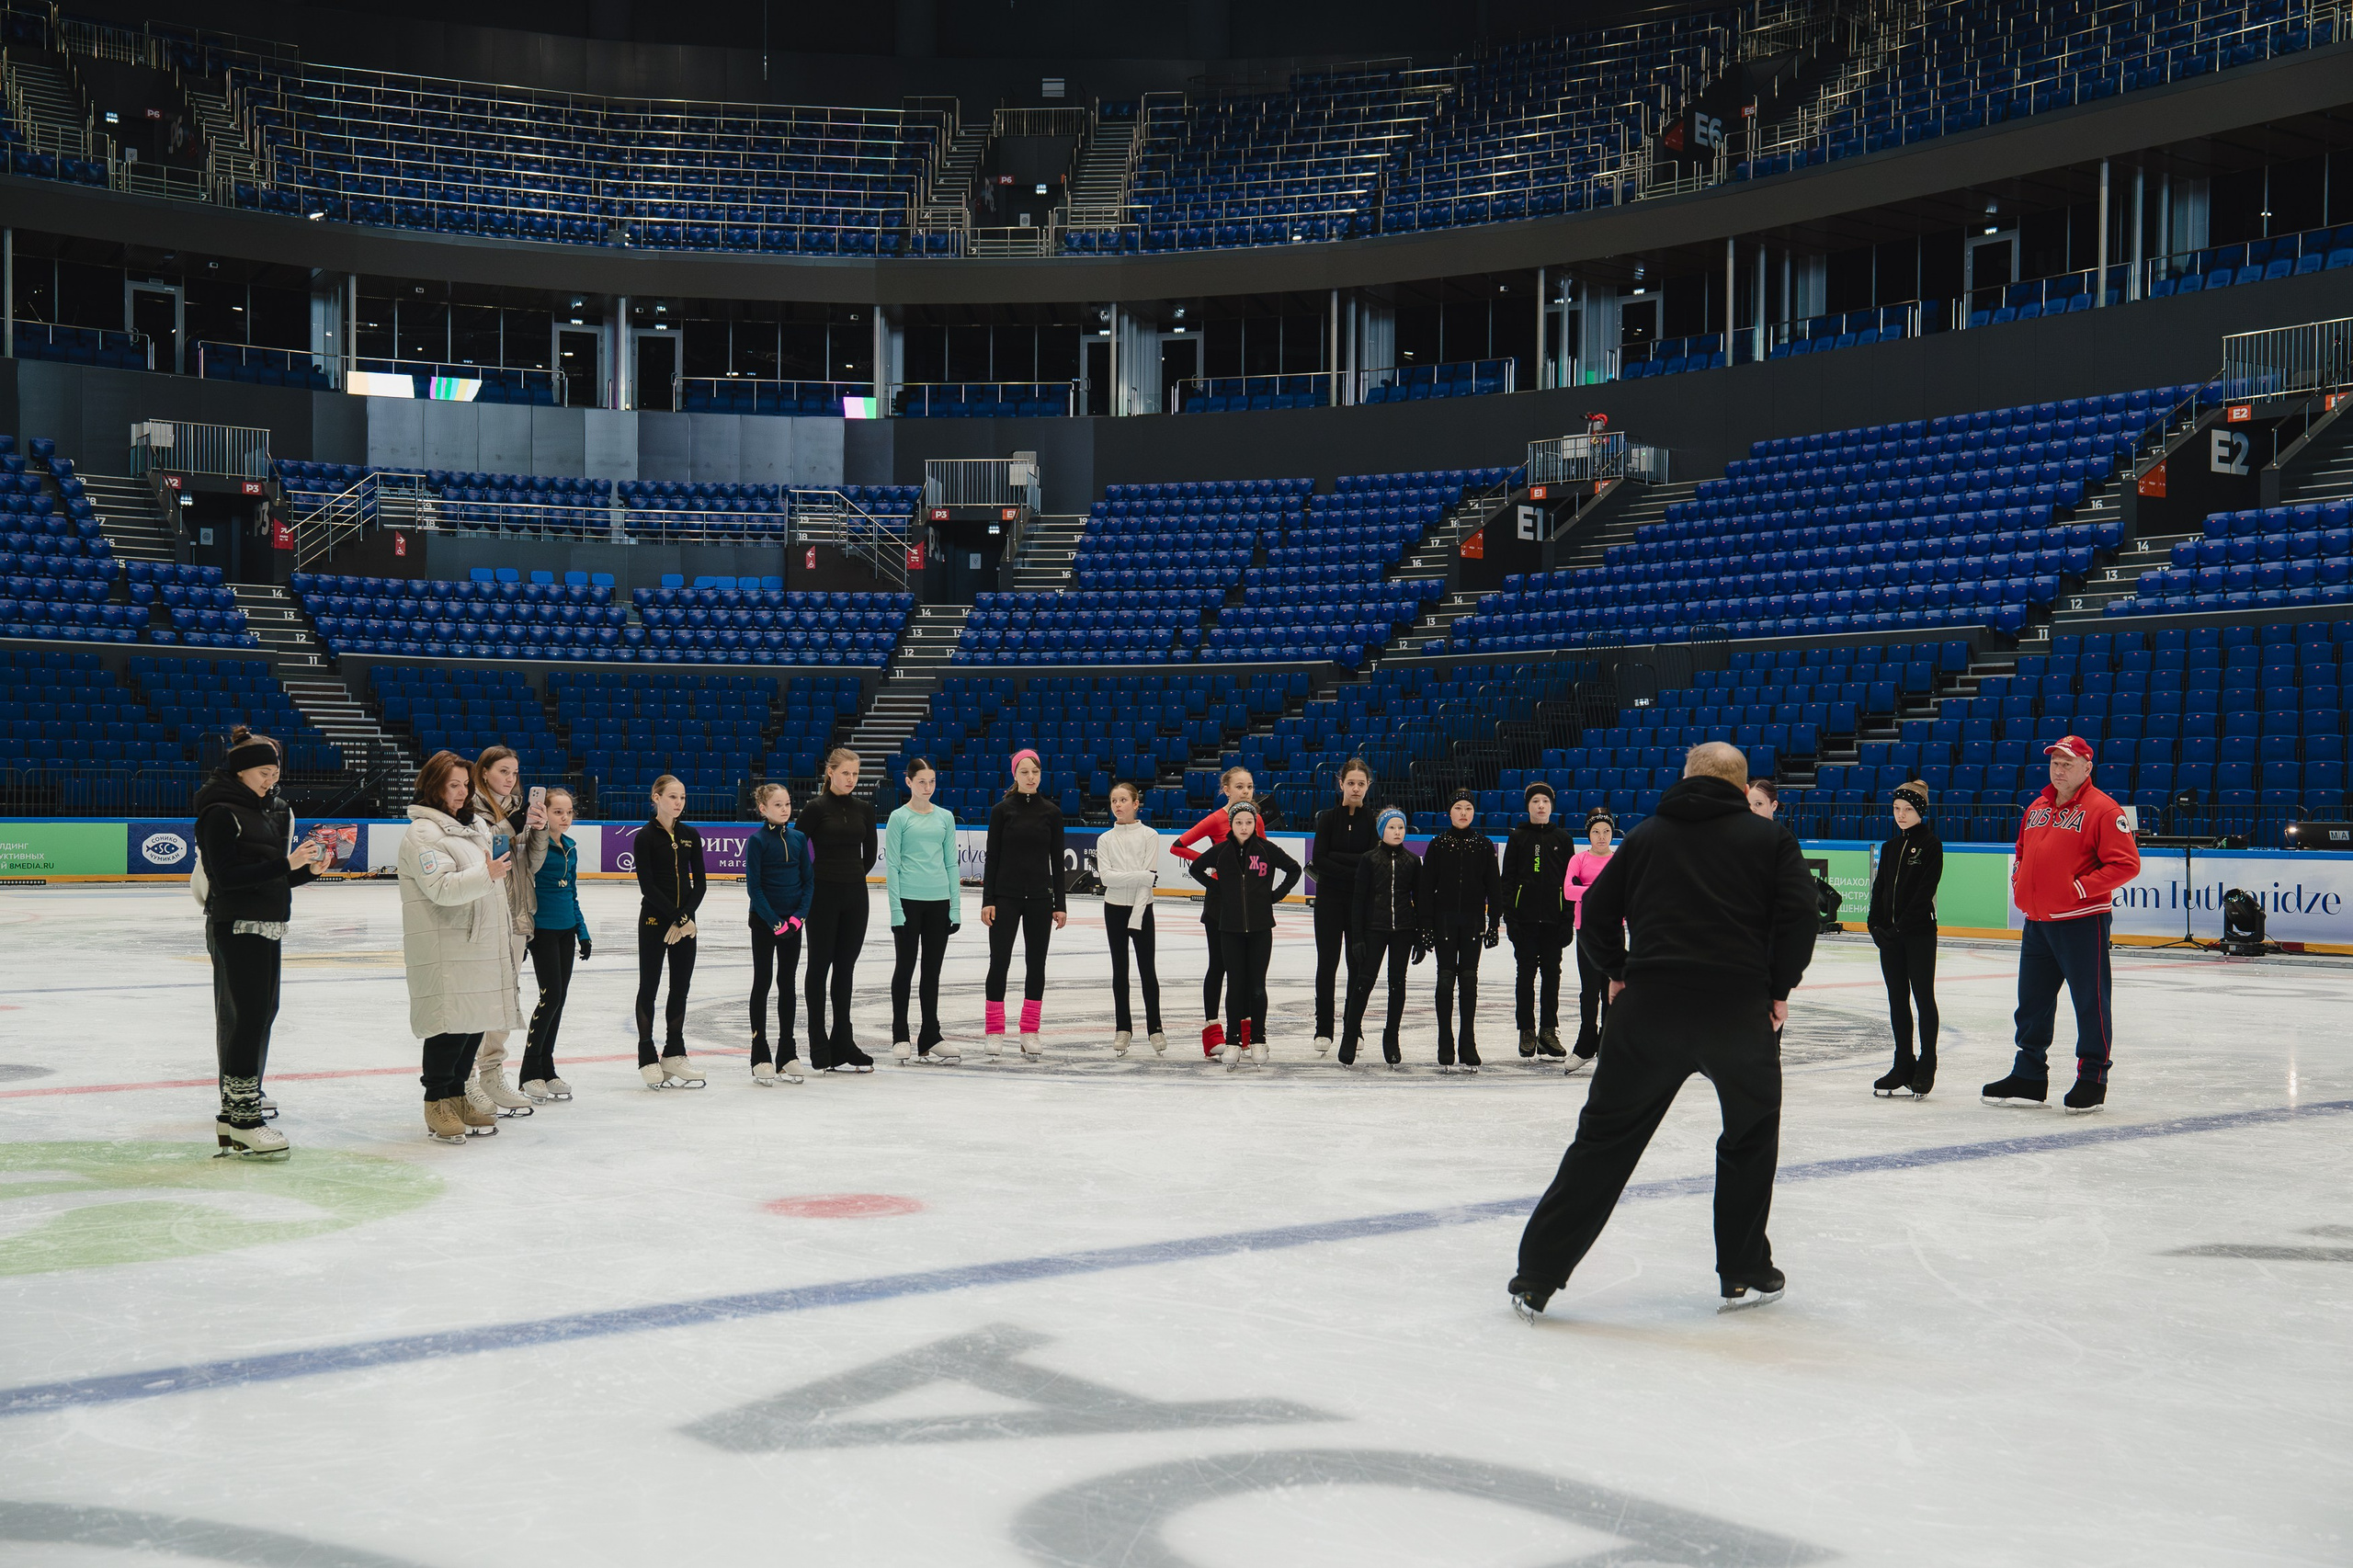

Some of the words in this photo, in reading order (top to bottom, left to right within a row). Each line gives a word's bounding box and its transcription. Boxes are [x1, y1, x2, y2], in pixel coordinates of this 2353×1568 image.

[147, 109, 160, 118] P6
[1694, 111, 1722, 150] E6
[2233, 408, 2248, 419] E2
[2211, 428, 2250, 475] E2
[245, 483, 259, 493] P3
[1534, 489, 1543, 497] E1
[2091, 500, 2103, 509] 16
[1518, 506, 1544, 541] E1
[2136, 540, 2149, 551] 14
[2105, 571, 2118, 581] 13
[272, 589, 282, 598] 14
[1454, 596, 1463, 604] 14
[2070, 598, 2083, 609] 12
[283, 611, 295, 619] 13
[921, 608, 931, 617] 14
[1427, 618, 1436, 626] 13
[295, 633, 306, 642] 12
[913, 629, 923, 637] 13
[2038, 629, 2049, 640] 11
[1399, 641, 1408, 649] 12
[904, 649, 915, 657] 12
[309, 656, 318, 665] 11
[895, 670, 904, 678] 11
[2025, 808, 2086, 833] RUSSIA
[159, 844, 170, 853] SC
[150, 853, 180, 862] ЧУМИКАН
